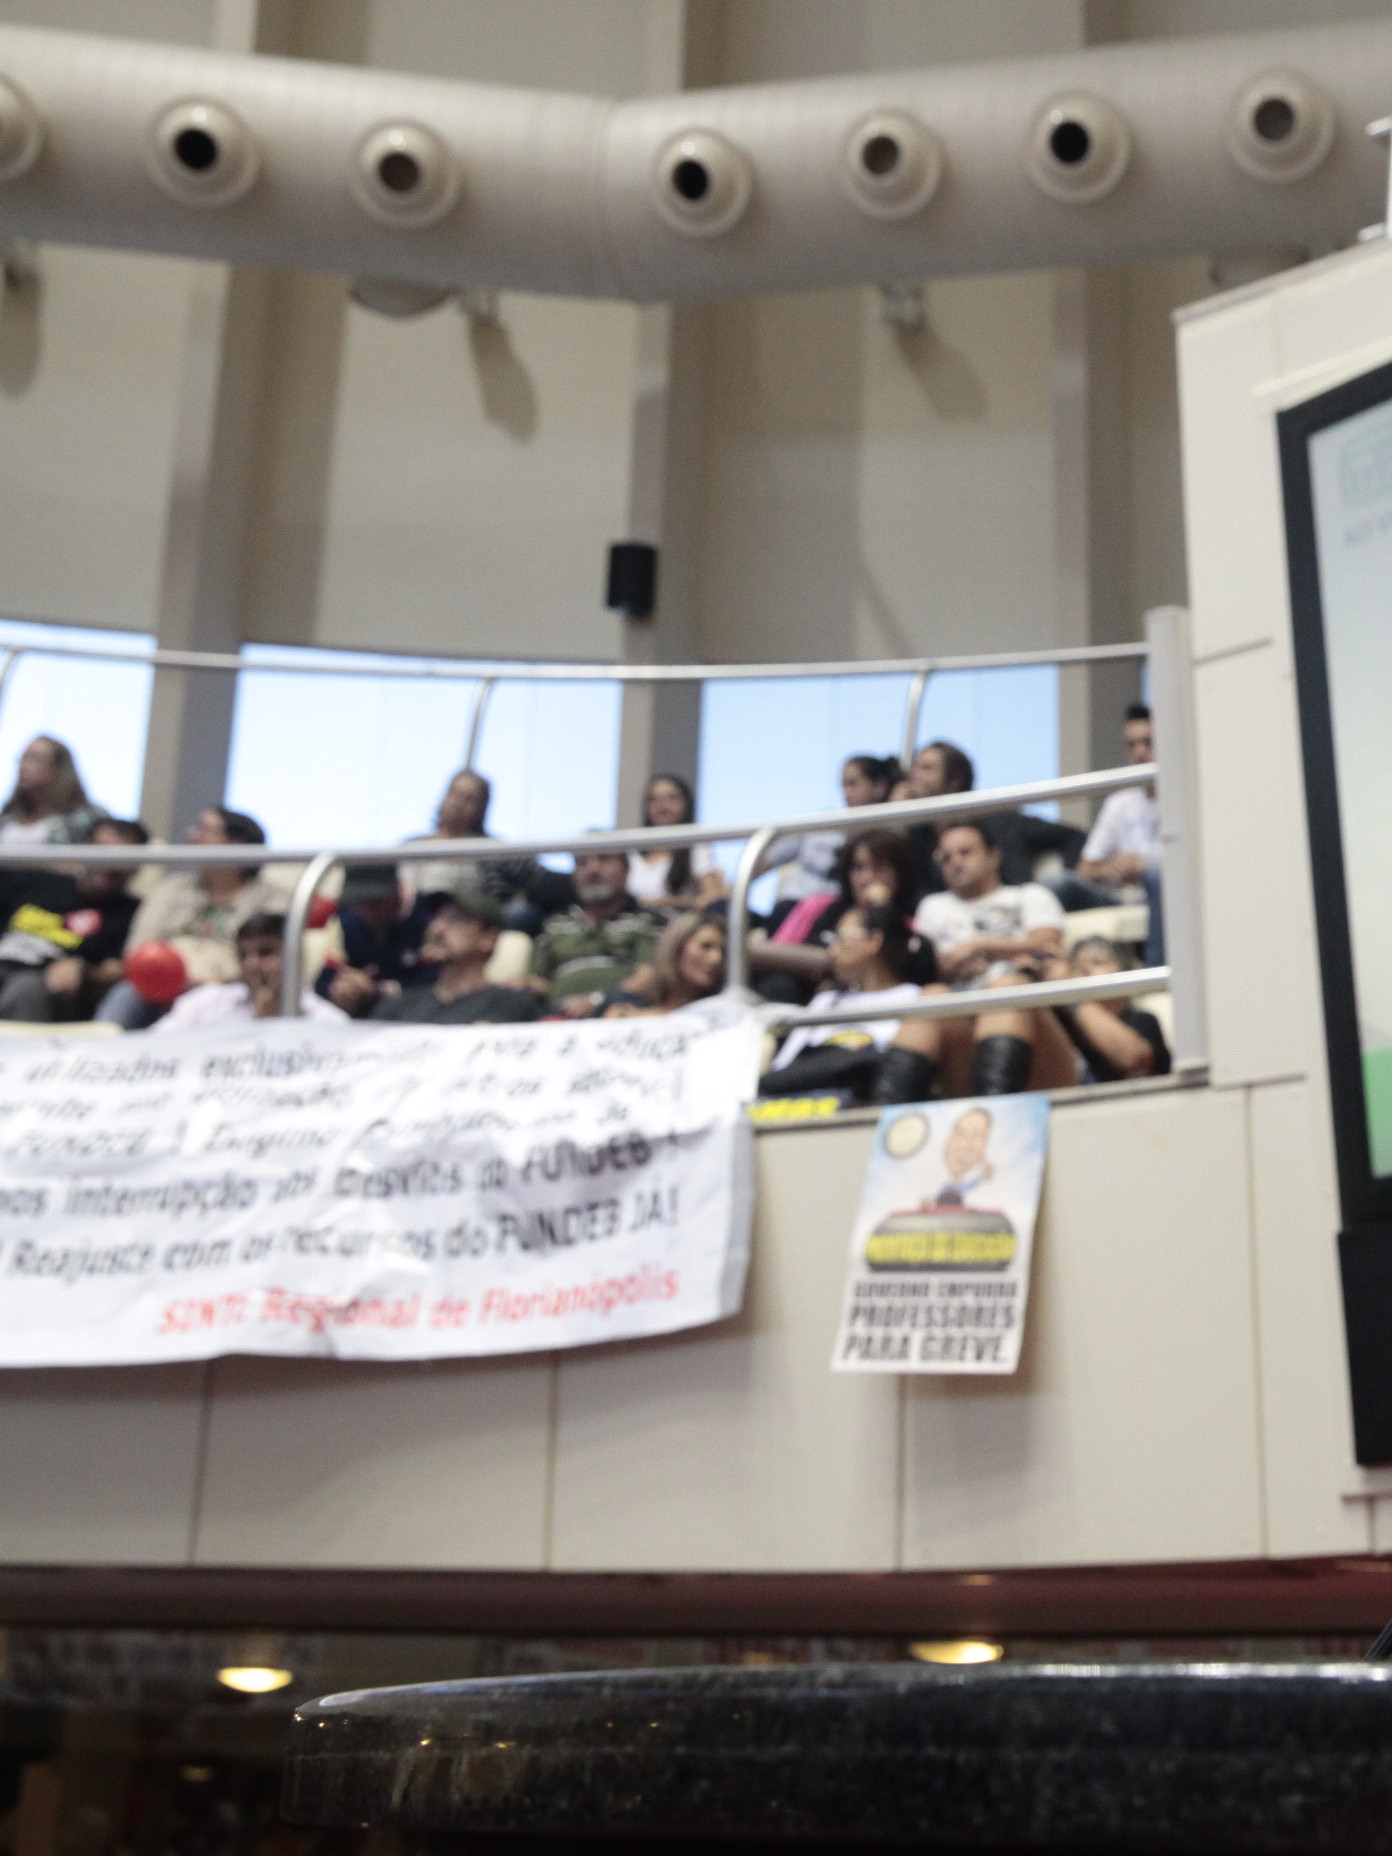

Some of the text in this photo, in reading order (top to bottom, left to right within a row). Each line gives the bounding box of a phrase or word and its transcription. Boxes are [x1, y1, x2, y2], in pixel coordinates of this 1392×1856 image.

[521, 1131, 652, 1184] FUNDEB
[162, 1240, 233, 1272] com
[443, 1219, 487, 1257] do
[261, 1286, 421, 1334] Regional
[431, 1290, 469, 1328] de
[480, 1260, 680, 1325] Florianópolis
[850, 1303, 1015, 1329] PROFESSORES
[842, 1334, 1005, 1363] PARA GREVE
